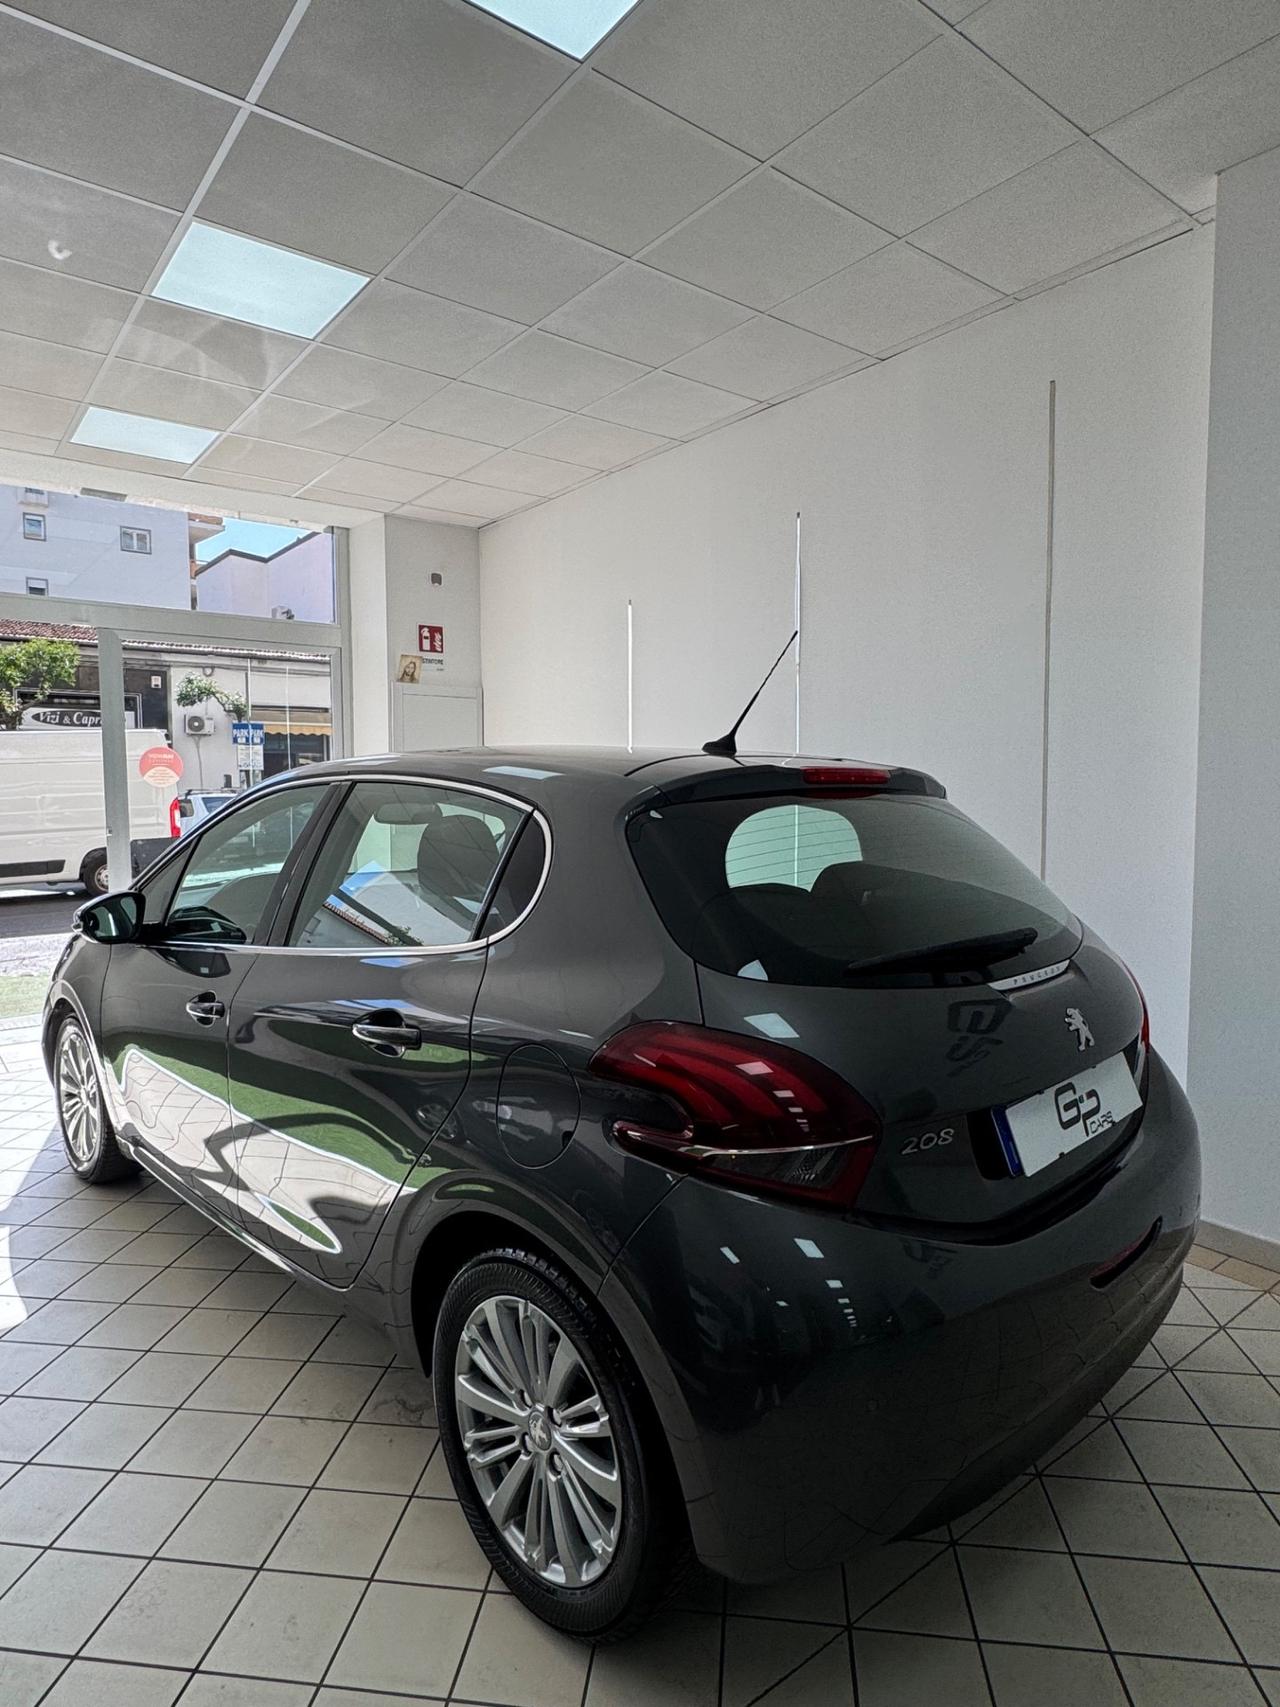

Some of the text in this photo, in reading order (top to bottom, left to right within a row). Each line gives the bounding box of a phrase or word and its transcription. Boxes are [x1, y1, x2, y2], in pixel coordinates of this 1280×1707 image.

[39, 711, 102, 727] Vizi & Capr
[901, 1128, 955, 1155] 208
